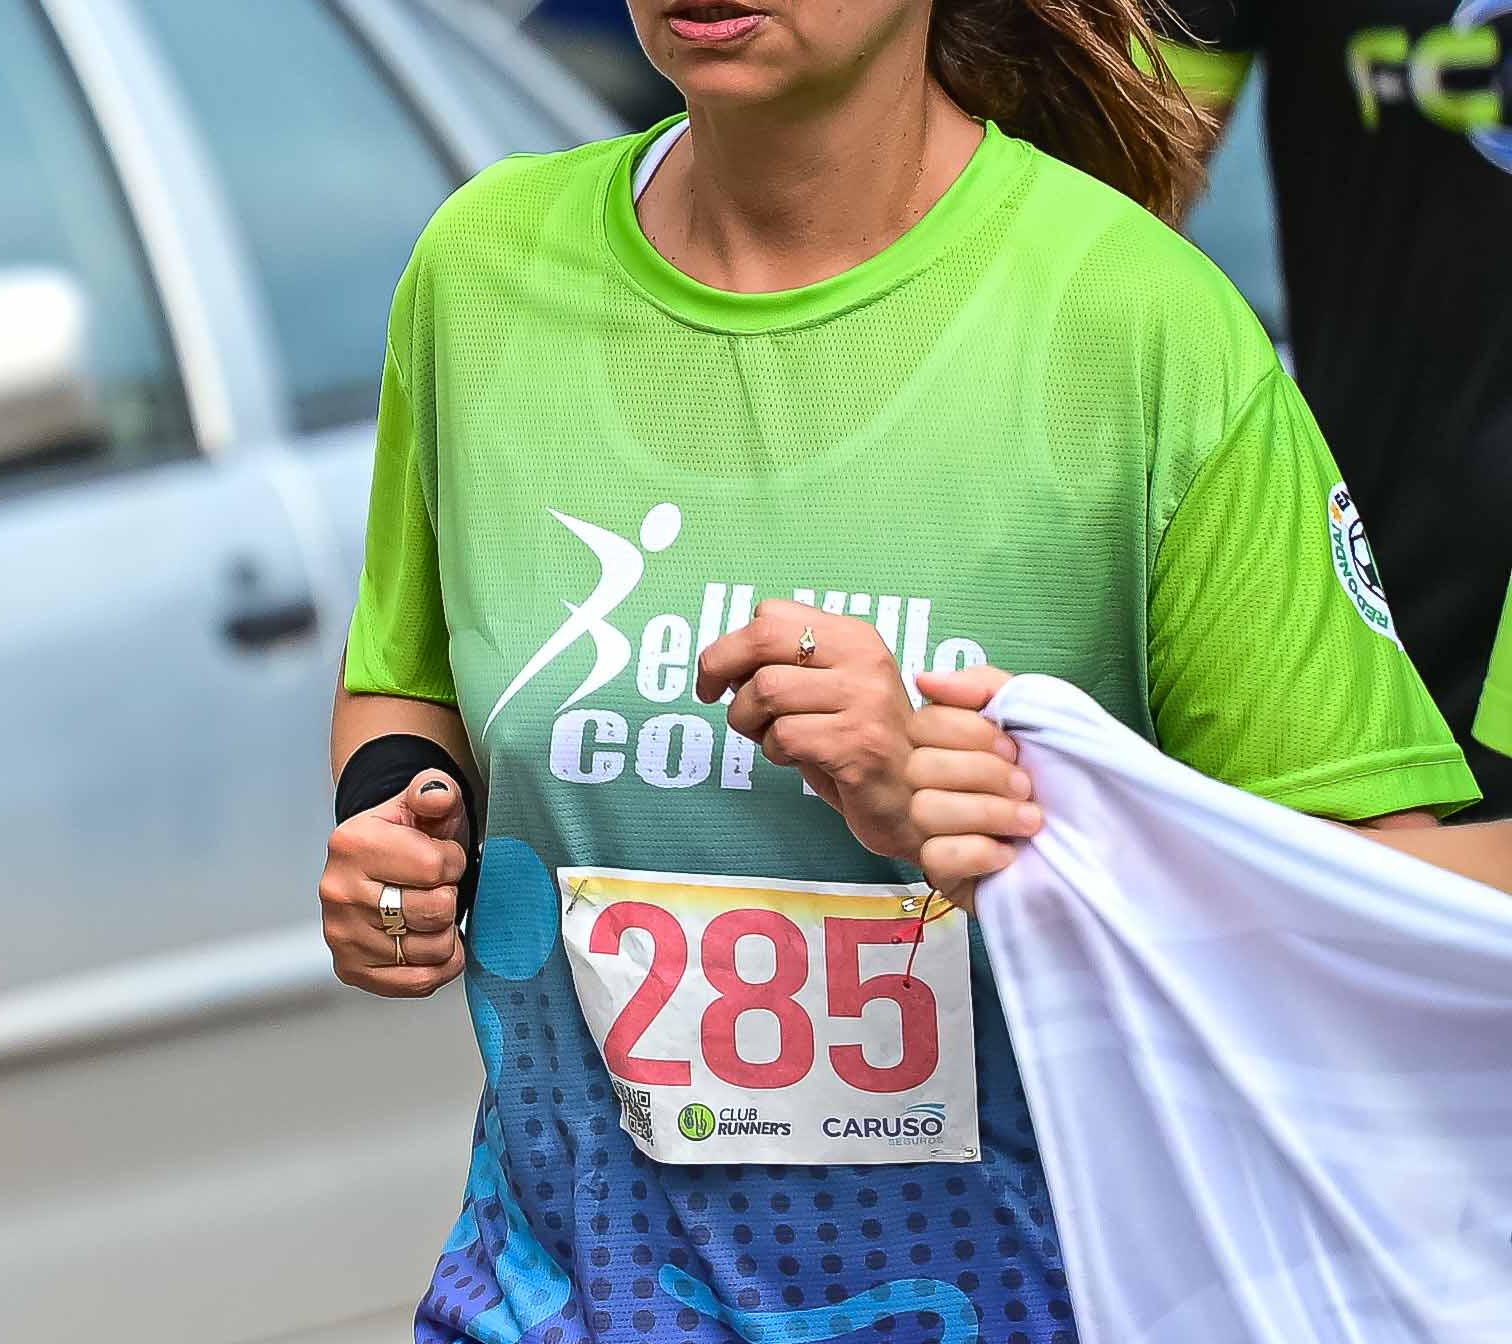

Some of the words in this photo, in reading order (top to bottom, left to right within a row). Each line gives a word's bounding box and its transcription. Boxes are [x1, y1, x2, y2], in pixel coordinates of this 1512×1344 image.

[589, 901, 940, 1093] 285
[719, 1108, 758, 1121] CLUB
[717, 1122, 791, 1136] RUNNER'S
[822, 1117, 943, 1137] CARUSO
